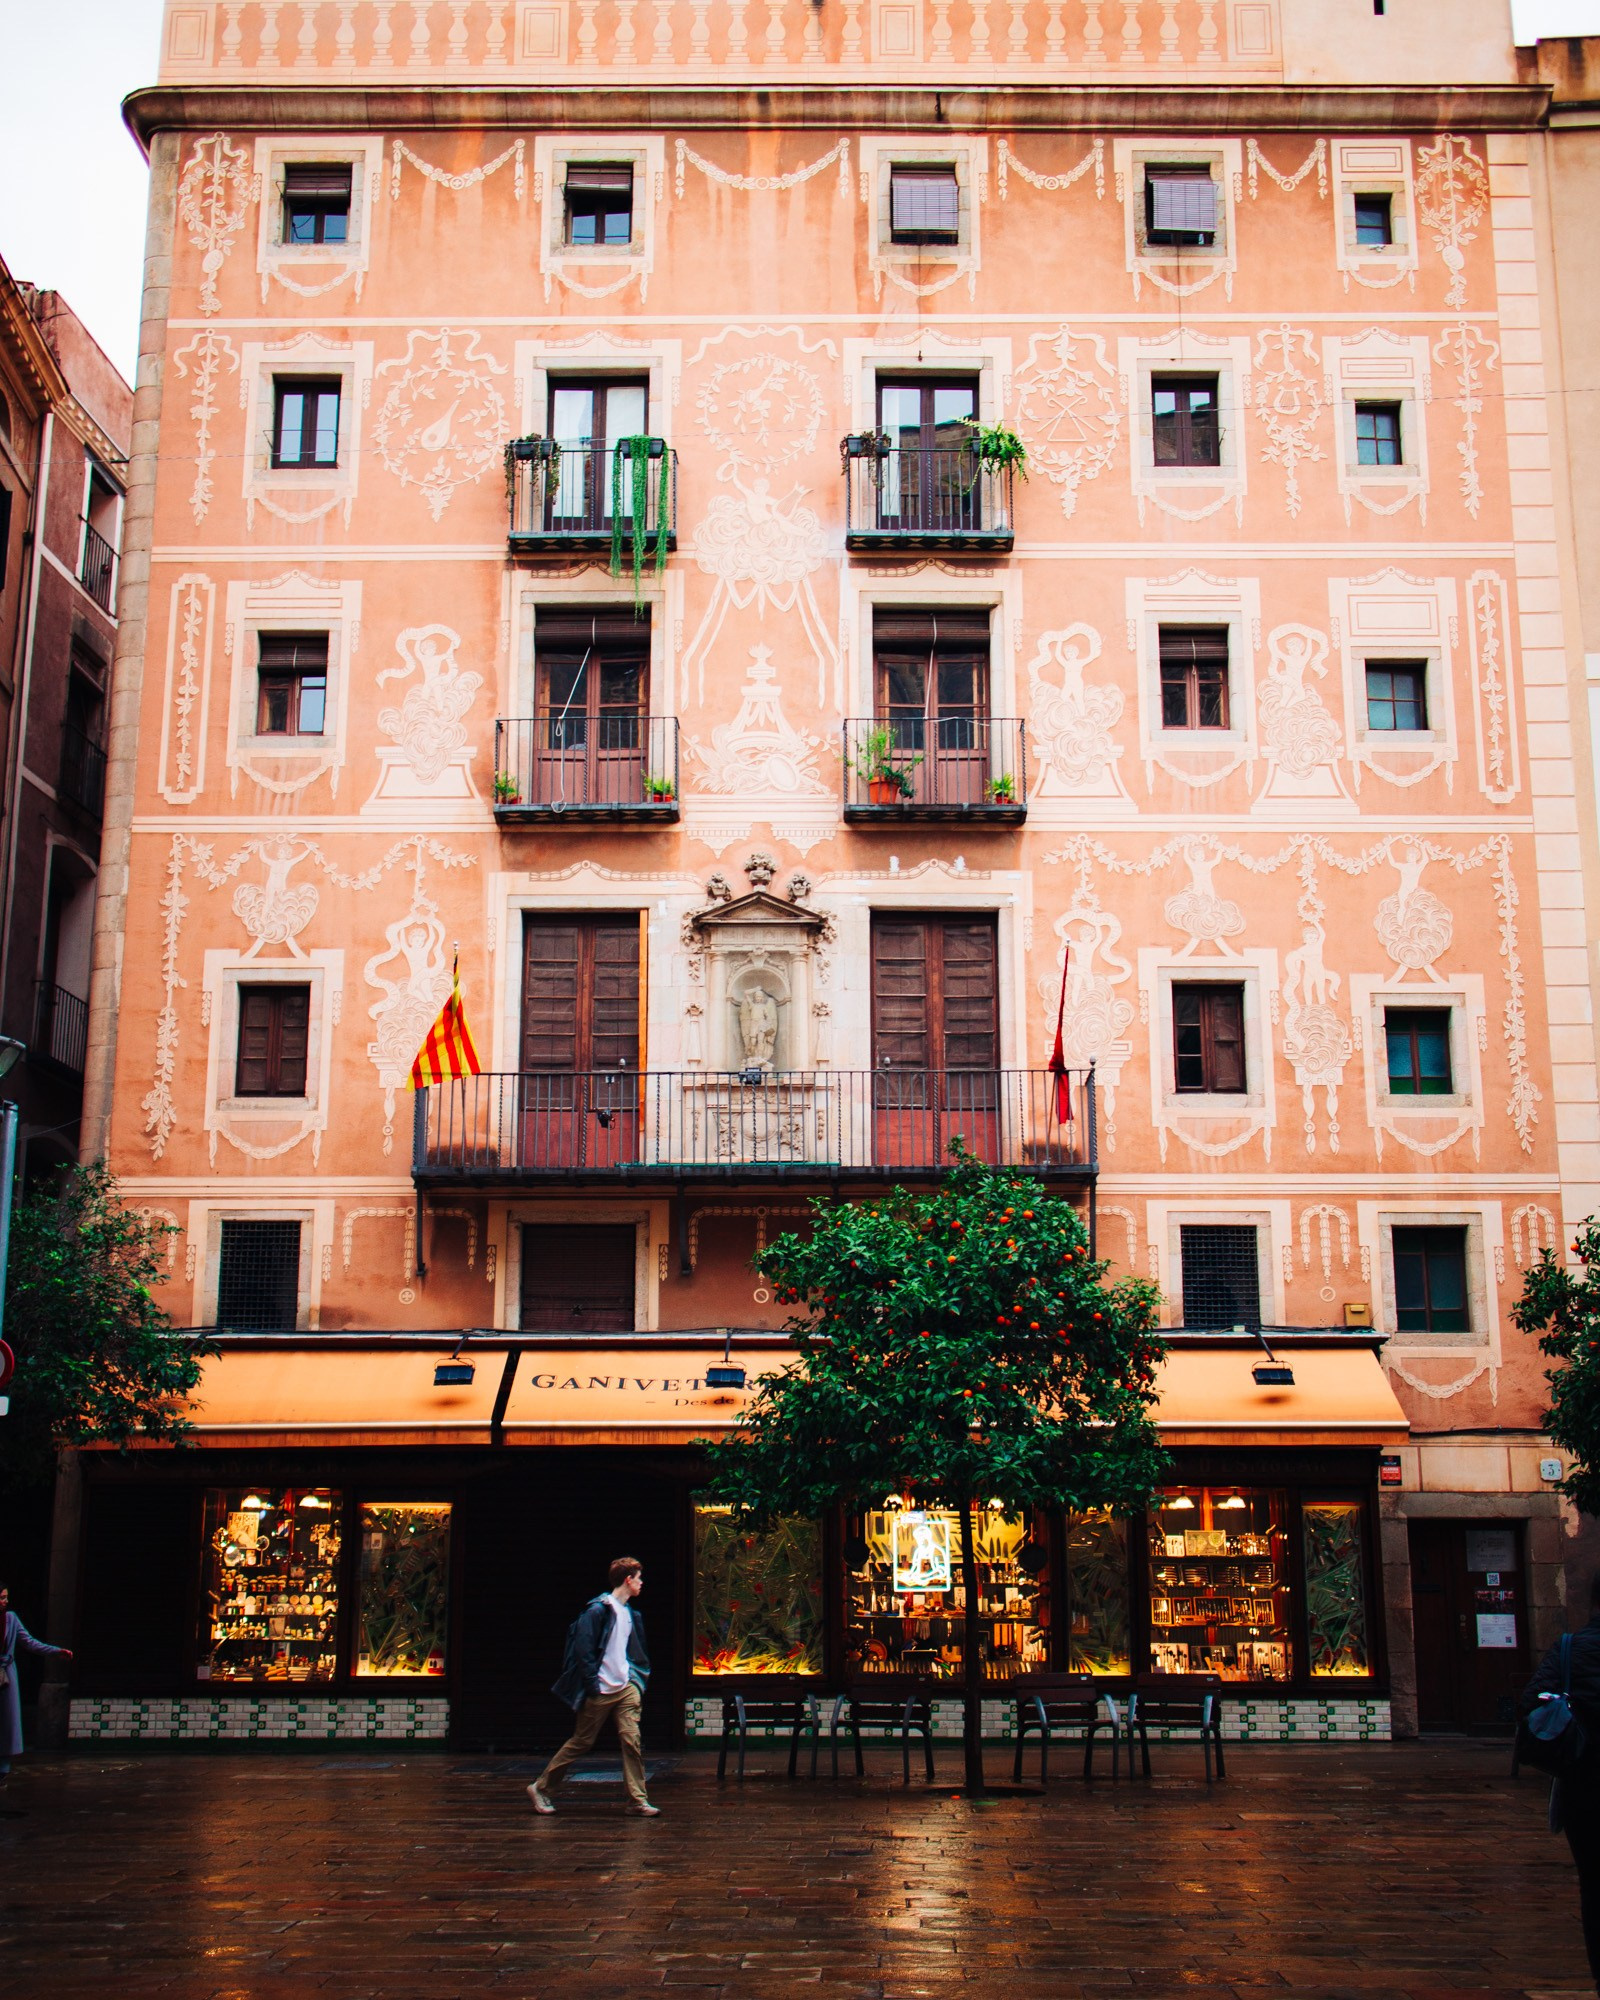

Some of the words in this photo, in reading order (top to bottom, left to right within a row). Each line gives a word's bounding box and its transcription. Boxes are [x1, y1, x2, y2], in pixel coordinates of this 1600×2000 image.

[674, 1398, 708, 1407] Des
[713, 1396, 735, 1405] de
[1547, 1463, 1555, 1477] 3
